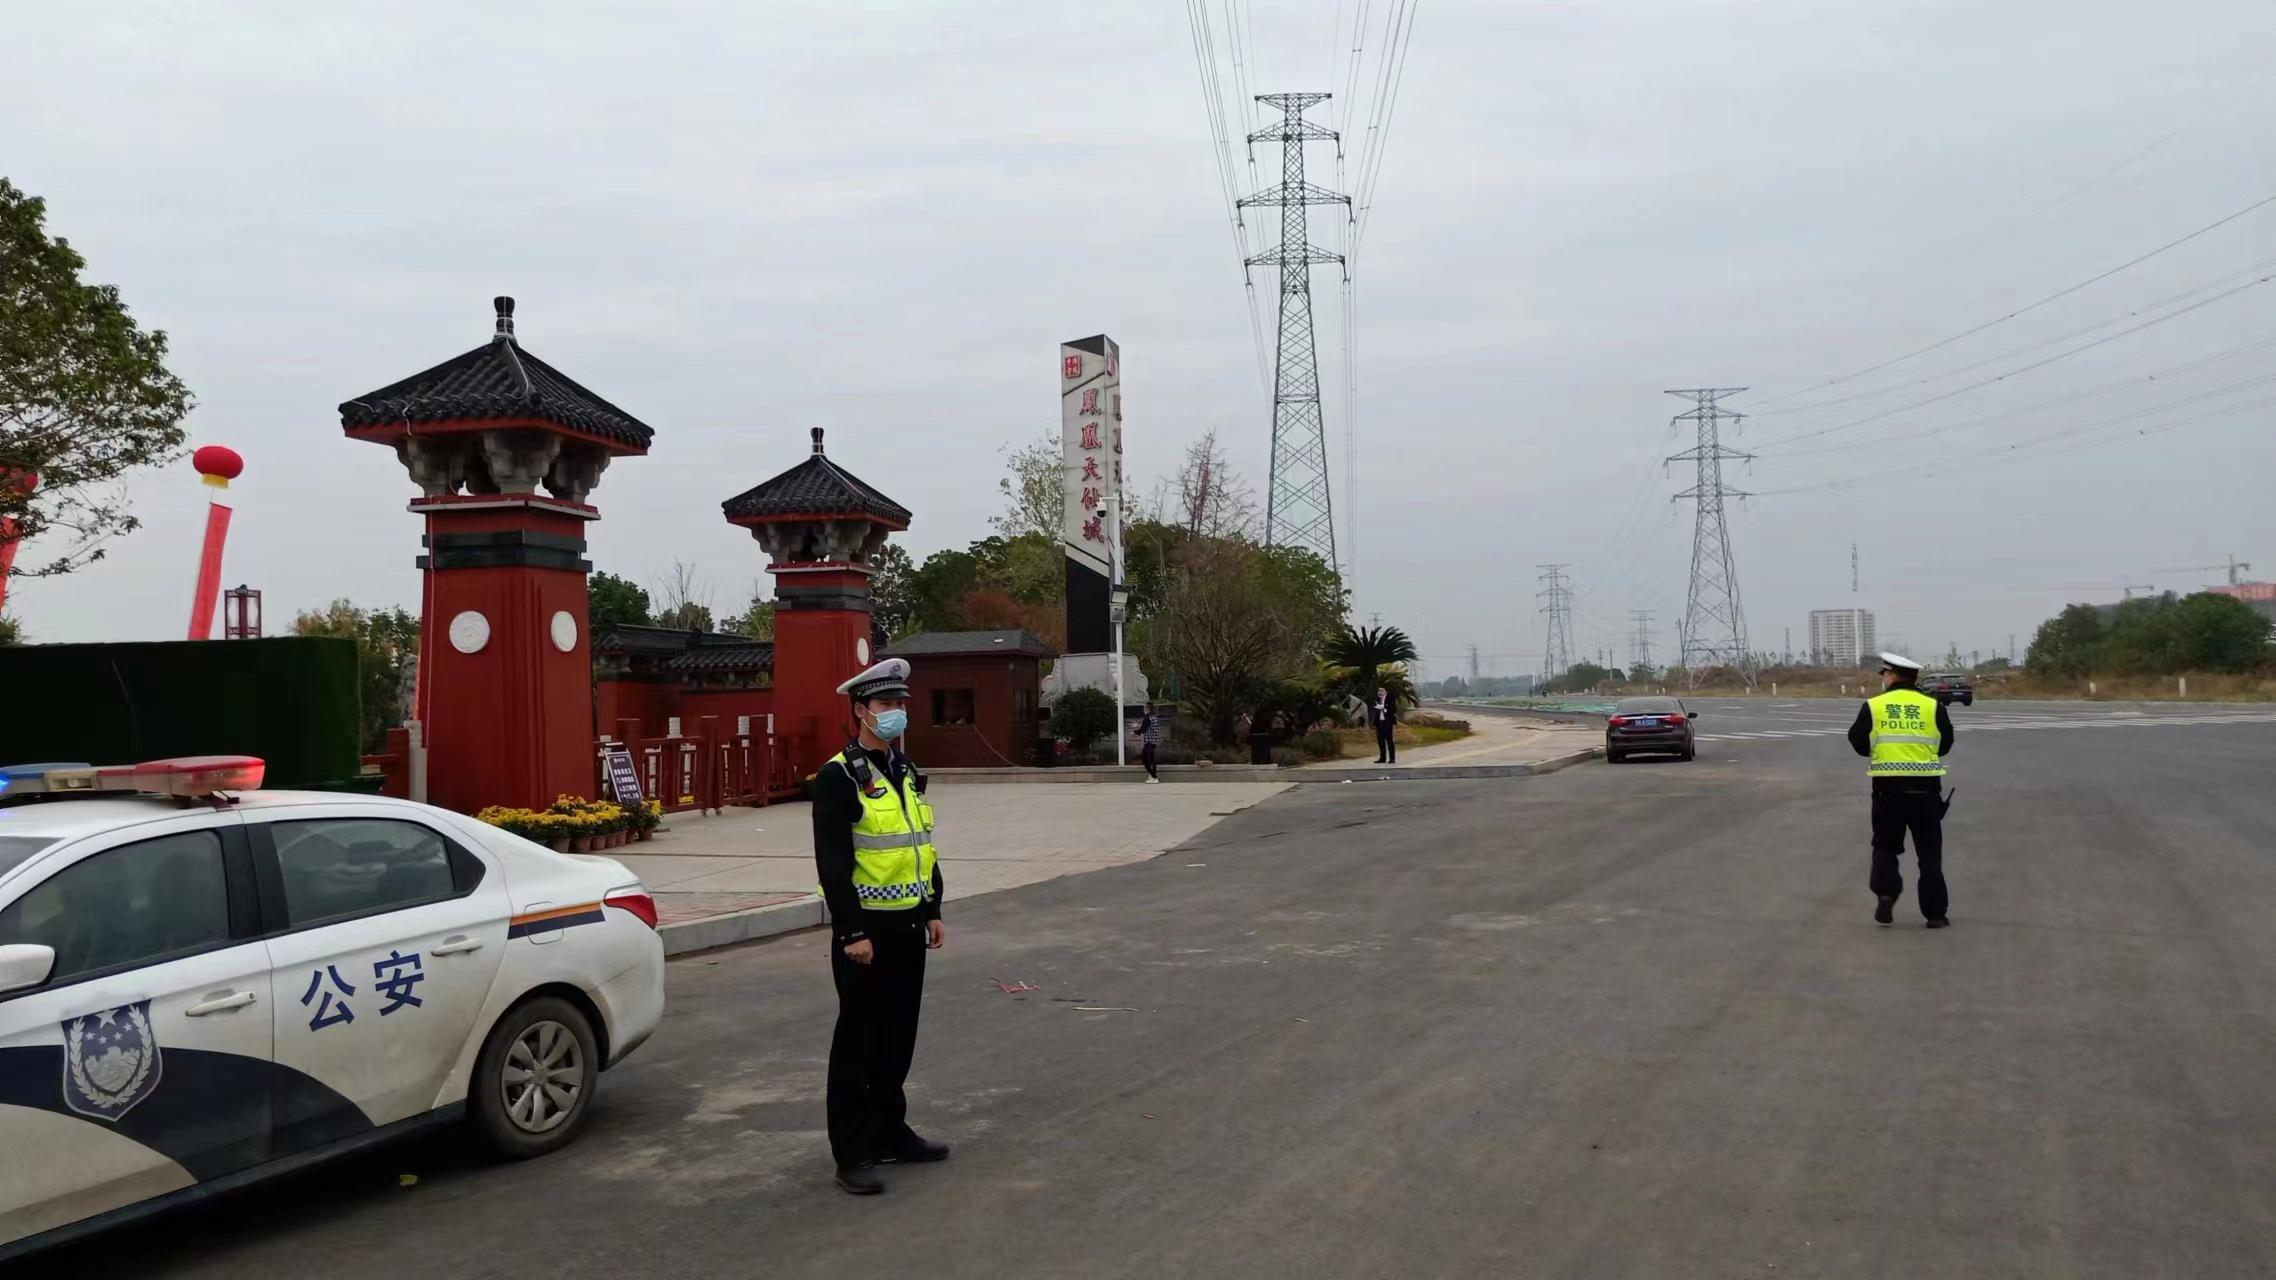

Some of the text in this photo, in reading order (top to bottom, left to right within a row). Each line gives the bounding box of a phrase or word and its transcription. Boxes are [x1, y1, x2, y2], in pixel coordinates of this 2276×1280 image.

[1885, 704, 1921, 719] 警察
[1880, 720, 1926, 731] POLICE
[301, 950, 424, 1032] 公安
